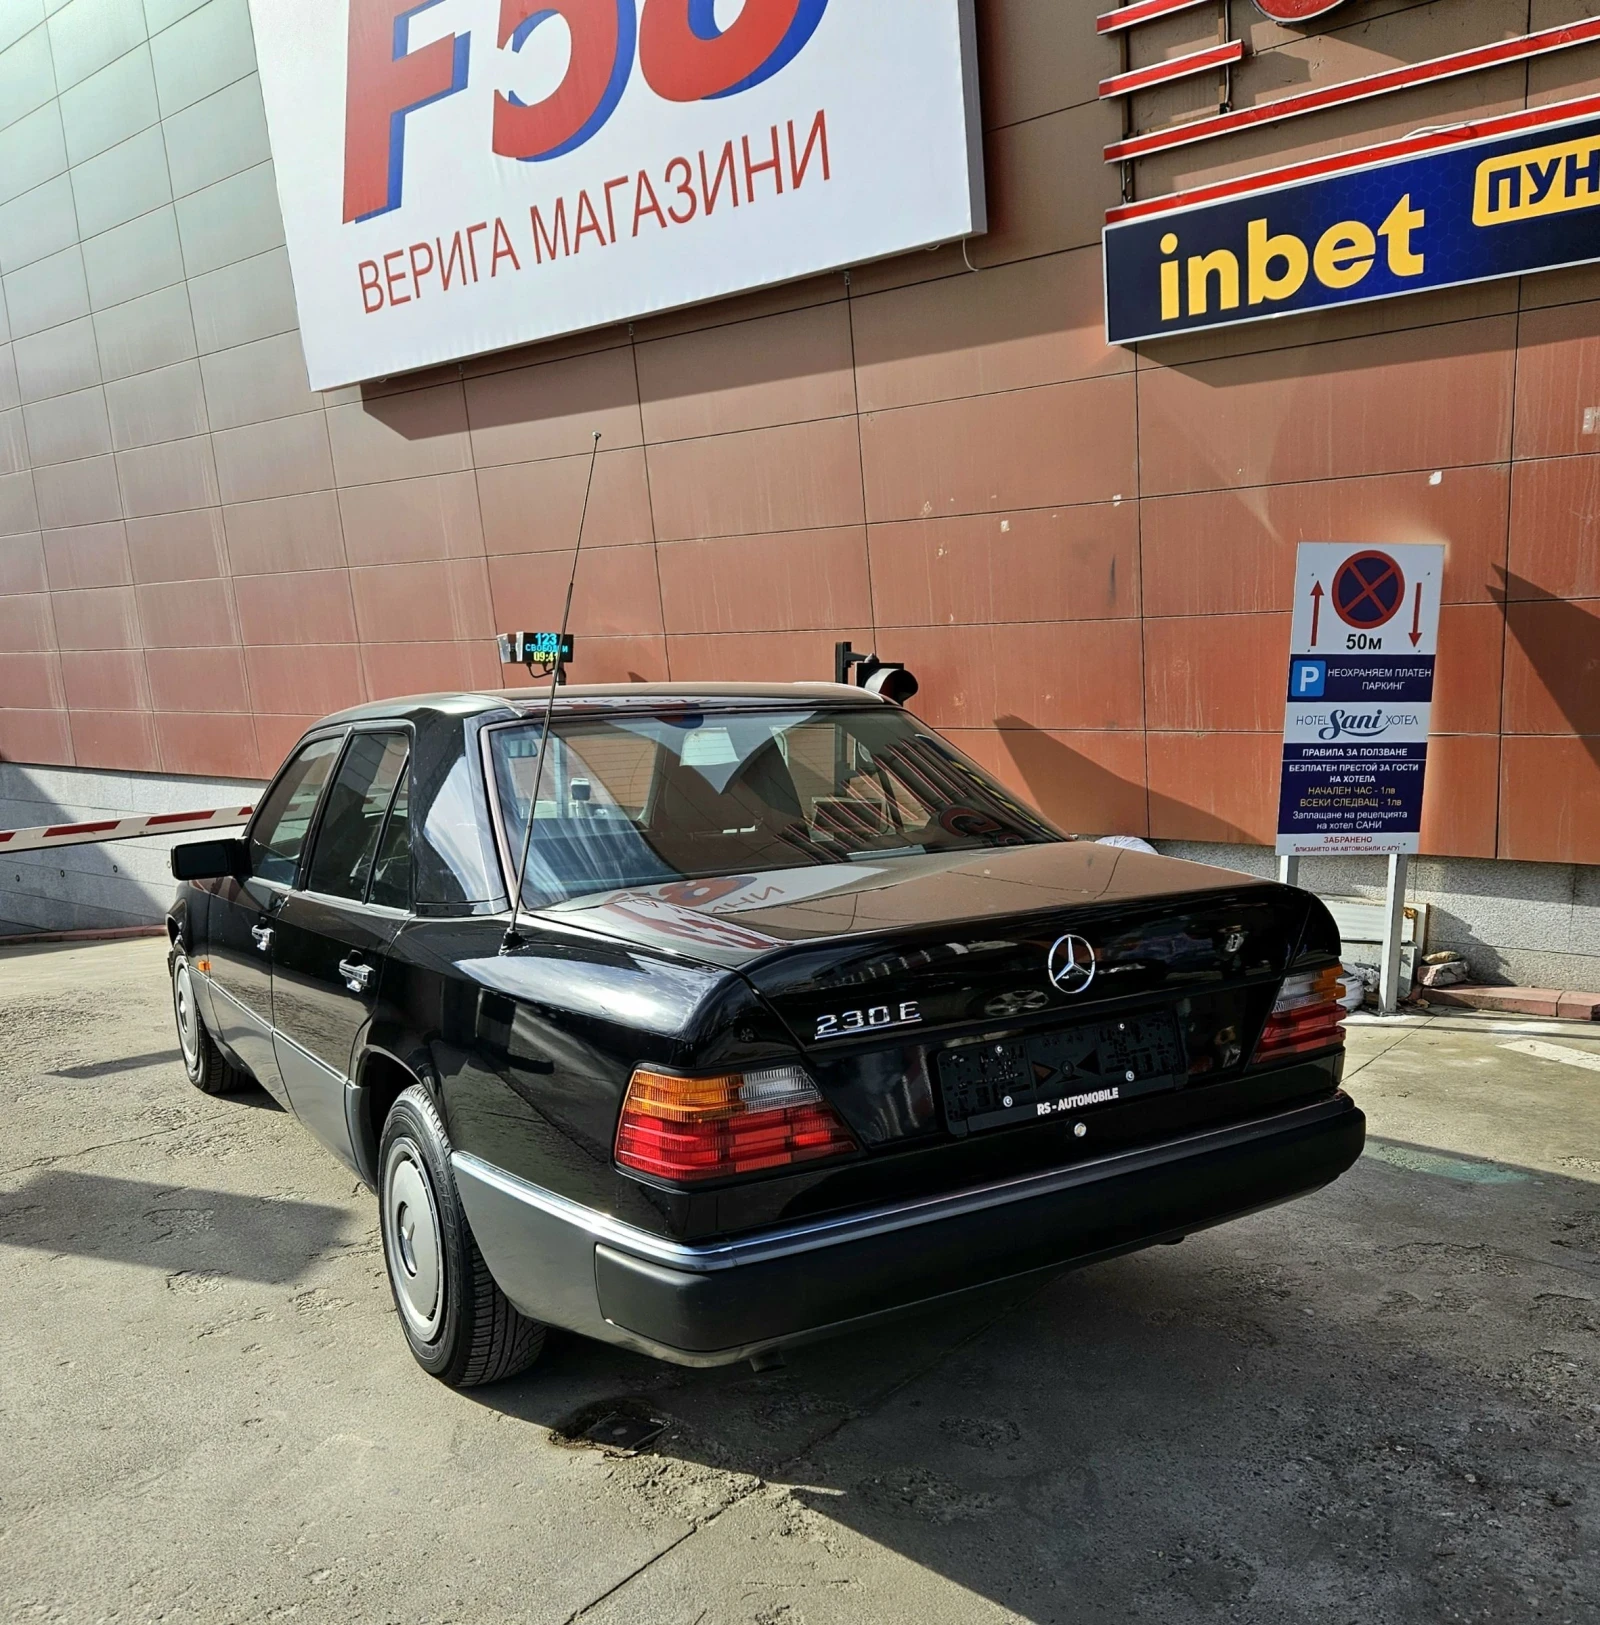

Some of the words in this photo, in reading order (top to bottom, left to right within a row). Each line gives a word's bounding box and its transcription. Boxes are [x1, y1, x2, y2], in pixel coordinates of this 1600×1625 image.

[1488, 148, 1600, 213] ПУН
[358, 217, 521, 314] ВЕРИГА
[530, 109, 831, 264] МАГАЗИНИ
[1159, 193, 1425, 321] inbet
[535, 632, 558, 646] 123
[1345, 633, 1382, 650] 50м
[525, 643, 569, 653] СВОБОДИ
[1327, 668, 1393, 678] НЕОХРАНЯЕМ
[1394, 668, 1432, 678] ПЛАТЕН
[1361, 681, 1405, 691] ПАРКИНГ
[1296, 715, 1330, 726] HOTEL
[1318, 709, 1384, 740] Sani
[1302, 748, 1344, 757] ПРАВИЛА
[1346, 748, 1358, 757] ЗА
[1360, 748, 1408, 757] ПОЛЗВАНЕ
[1289, 764, 1337, 772] БЕЗПЛАТЕН
[1339, 762, 1378, 772] ПРЕСТОЙ
[1379, 763, 1391, 772] ЗА
[1392, 763, 1419, 772] ГОСТИ
[1329, 775, 1342, 783] НА
[1343, 775, 1376, 783] ХОТЕЛА
[1308, 786, 1352, 795] НАЧАЛЕН
[1354, 786, 1373, 795] ЧАС
[1380, 786, 1396, 795] 1лв
[1300, 798, 1331, 807] ВСЕКИ
[1333, 798, 1379, 808] СЛЕДВАЩ
[1387, 798, 1402, 806] 1лв
[1293, 811, 1342, 820] Заплащане
[1357, 811, 1408, 821] рецепцията
[1316, 822, 1327, 830] на
[1329, 822, 1354, 830] хотел
[1355, 820, 1382, 830] САНИ
[1323, 836, 1373, 844] ЗАБРАНЕНО
[816, 1006, 890, 1035] 230
[899, 1000, 921, 1021] E
